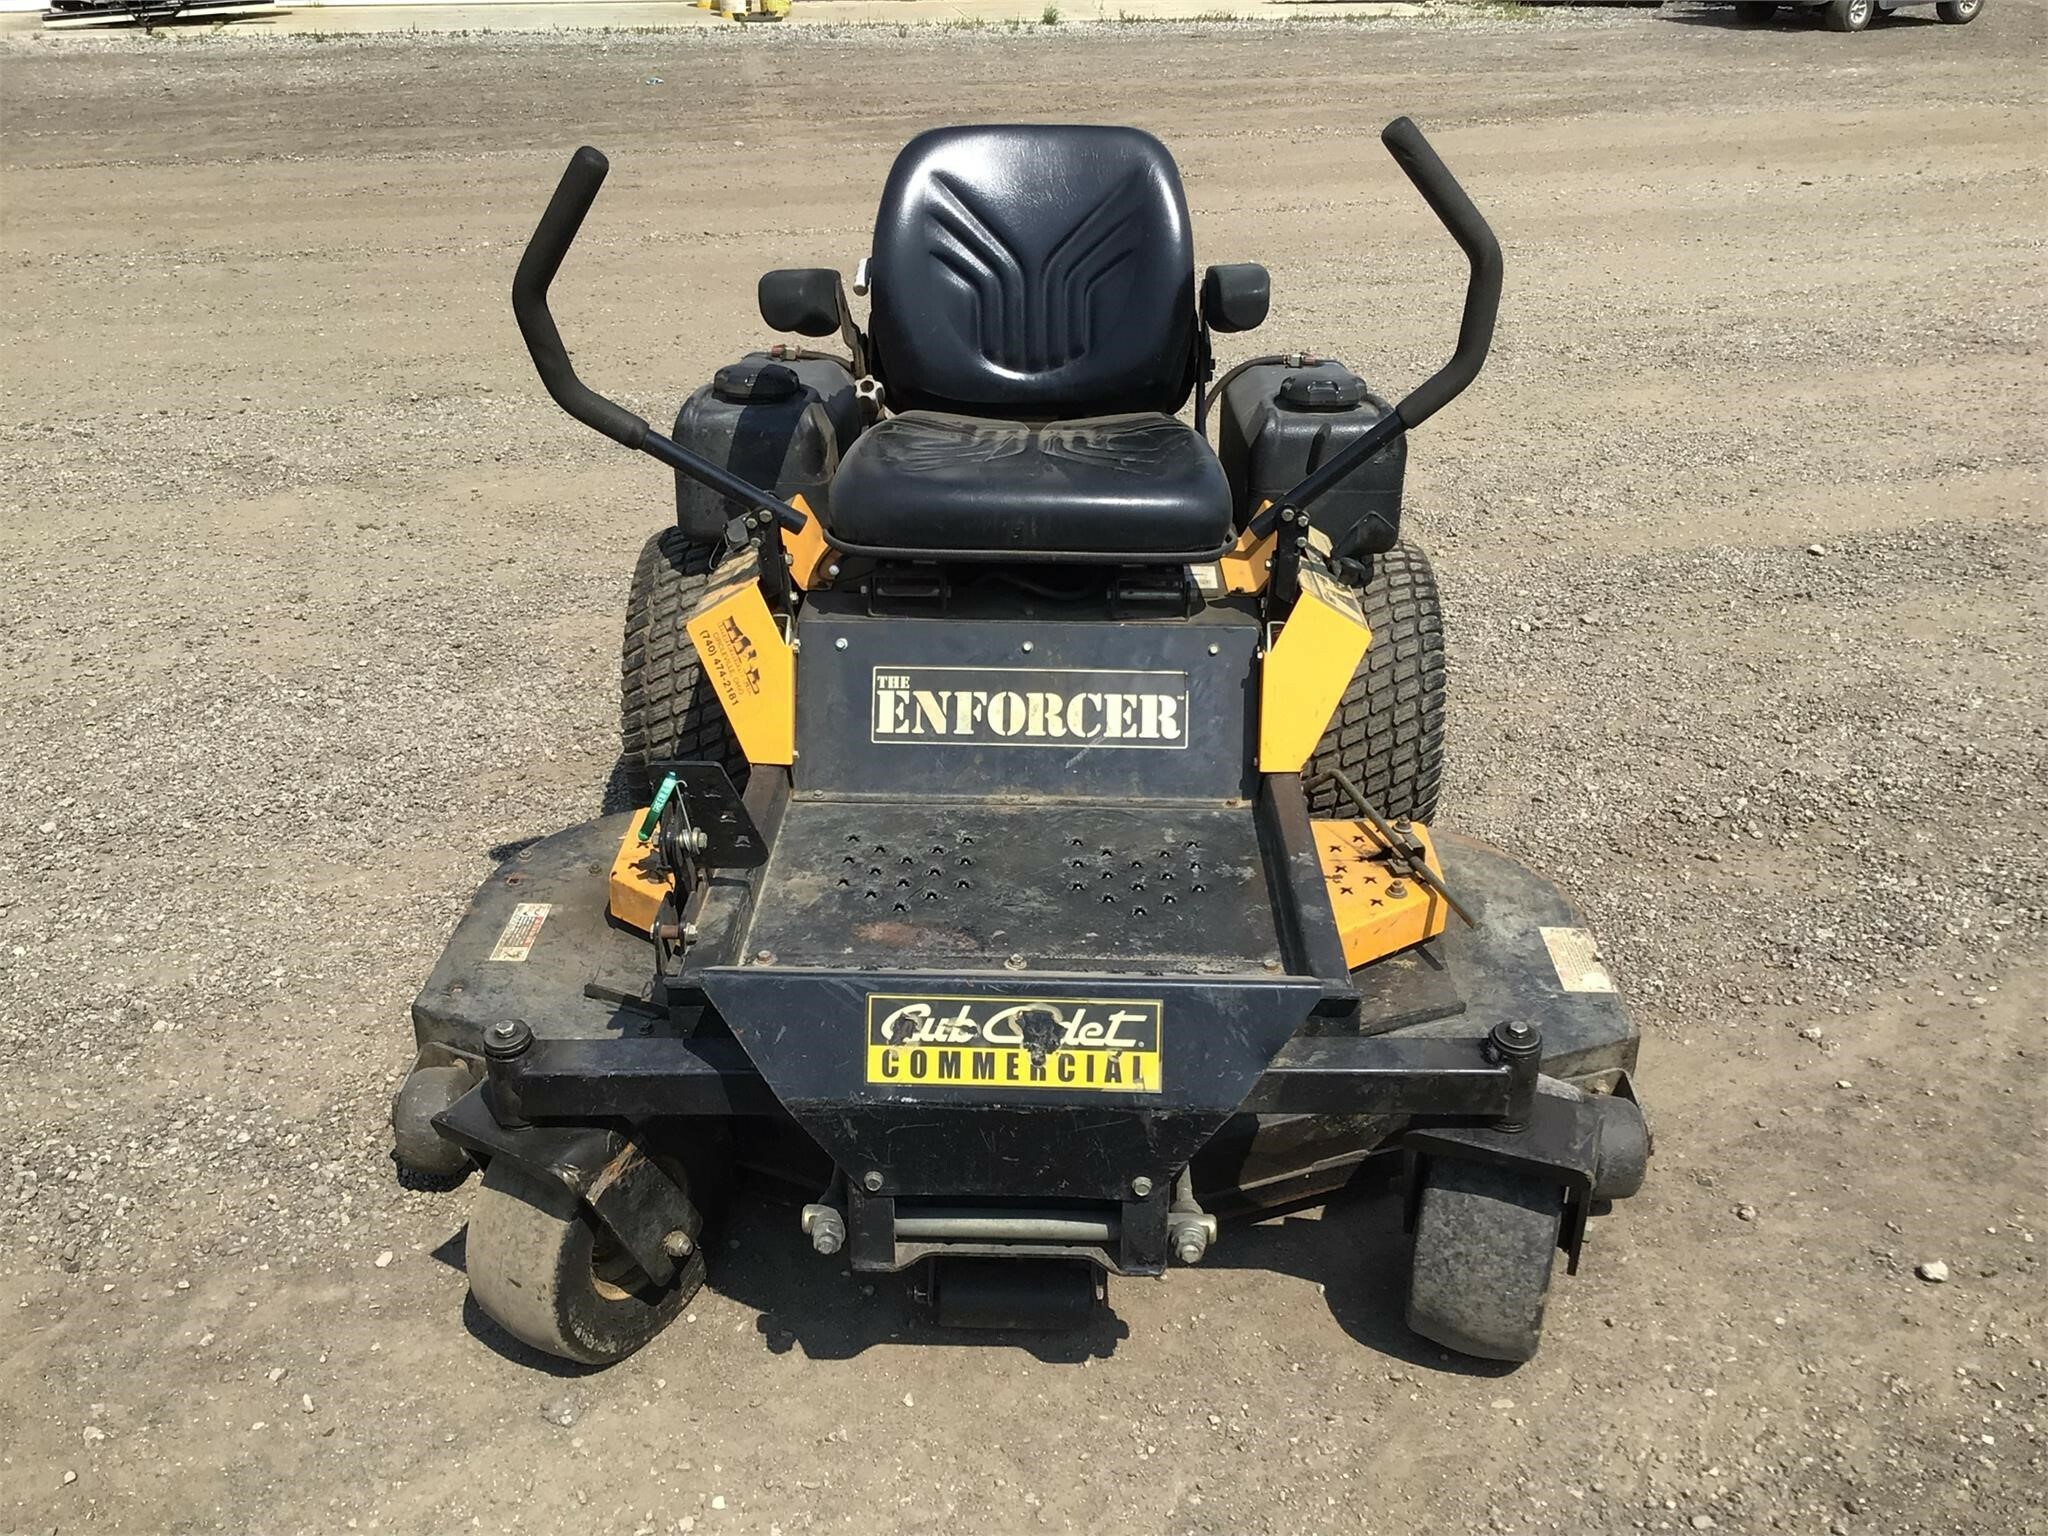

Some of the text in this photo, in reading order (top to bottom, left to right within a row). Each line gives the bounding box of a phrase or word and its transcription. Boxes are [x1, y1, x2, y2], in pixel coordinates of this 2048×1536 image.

[699, 630, 717, 656] (740)
[713, 657, 739, 706] 474-2181
[876, 675, 911, 690] THE
[982, 1003, 1148, 1048] Cdet
